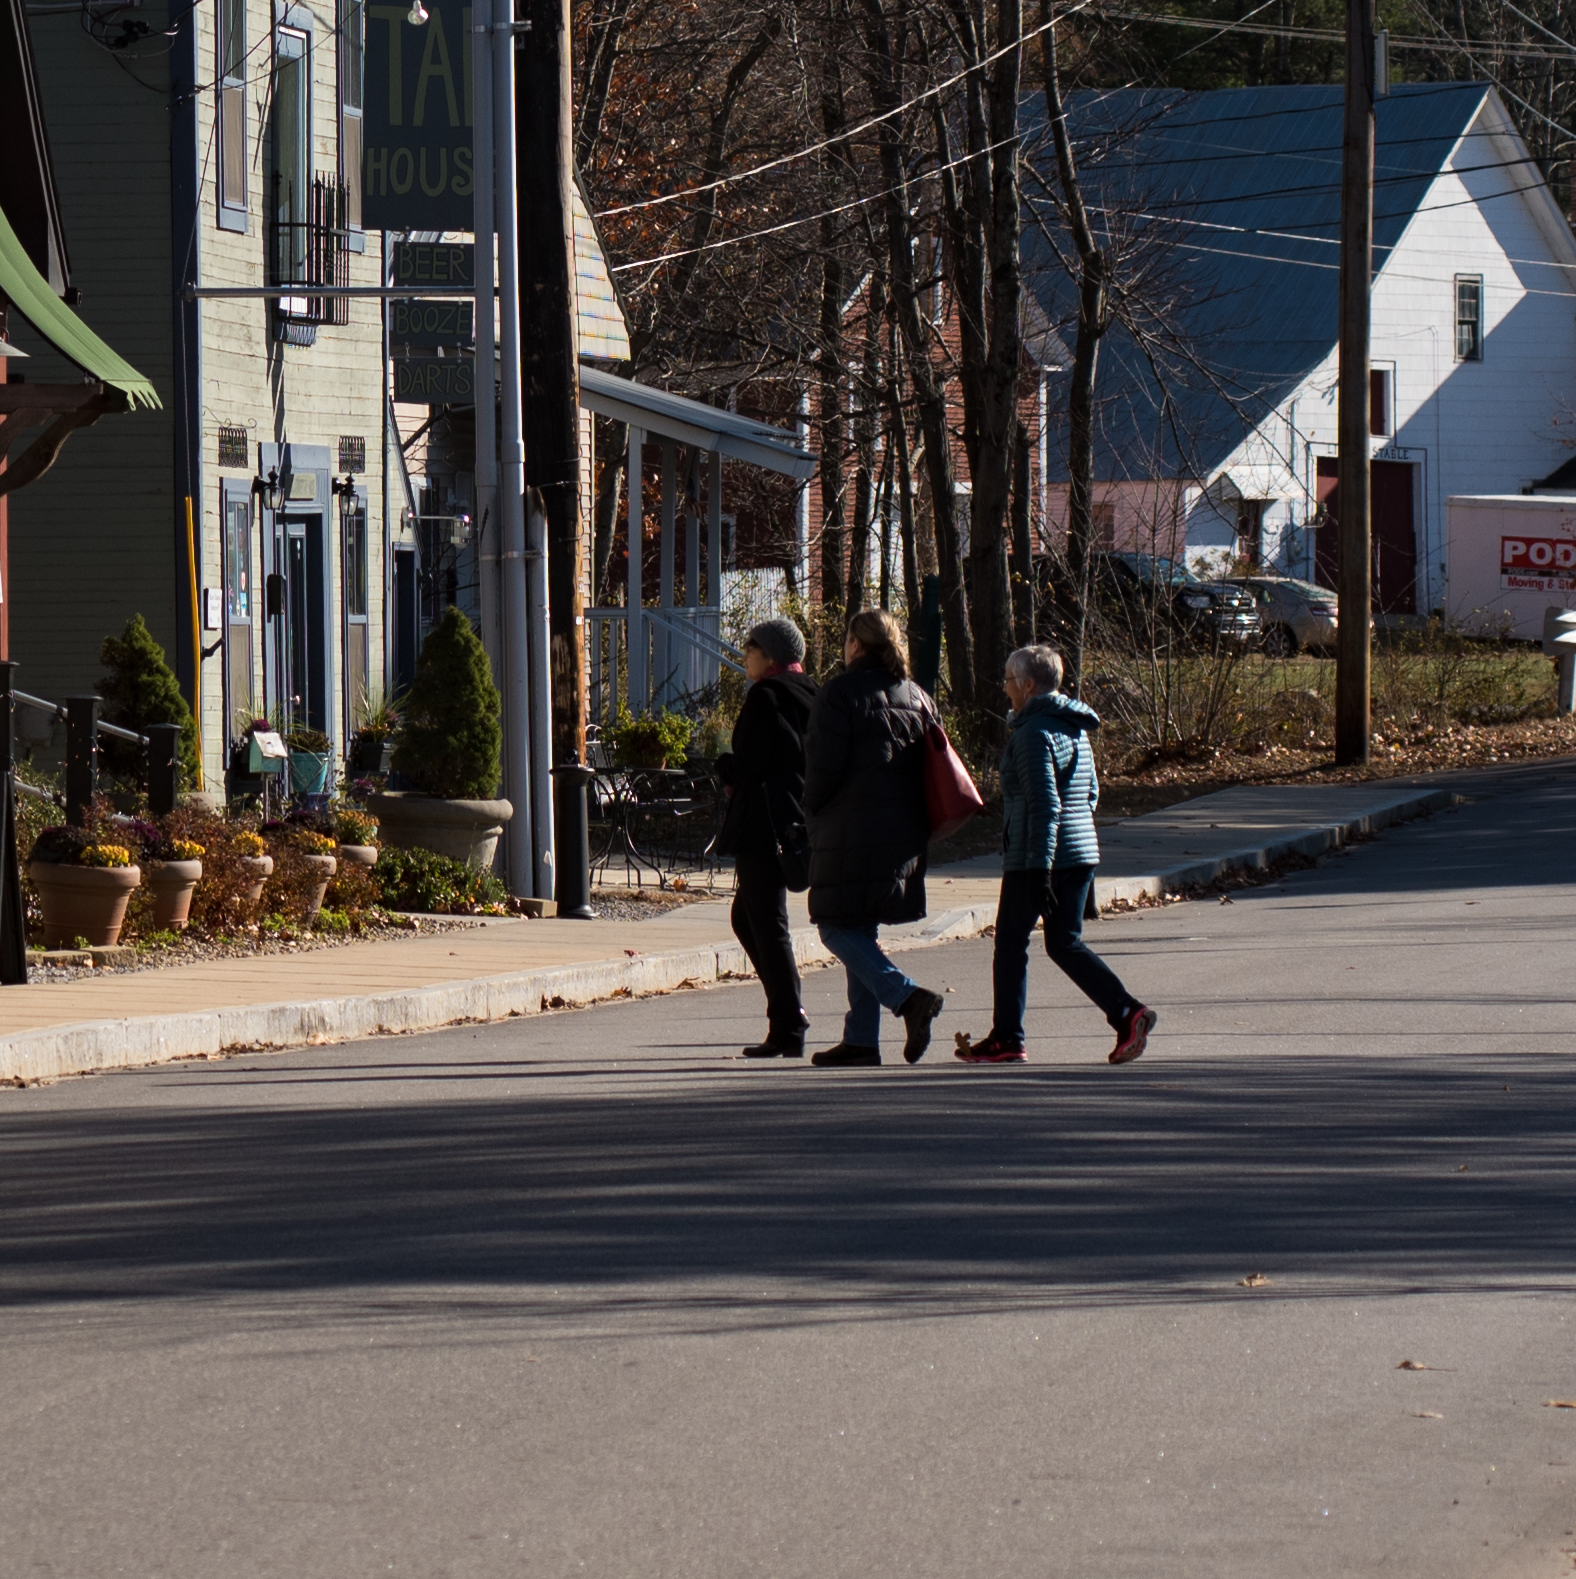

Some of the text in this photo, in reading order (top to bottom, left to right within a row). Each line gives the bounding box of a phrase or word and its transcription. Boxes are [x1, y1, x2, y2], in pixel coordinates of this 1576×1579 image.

[366, 146, 495, 197] HOUS
[399, 245, 470, 281] BEER
[396, 304, 471, 335] BOOZE
[398, 363, 472, 394] DARTS
[1507, 577, 1544, 590] Moving
[1547, 579, 1554, 588] &
